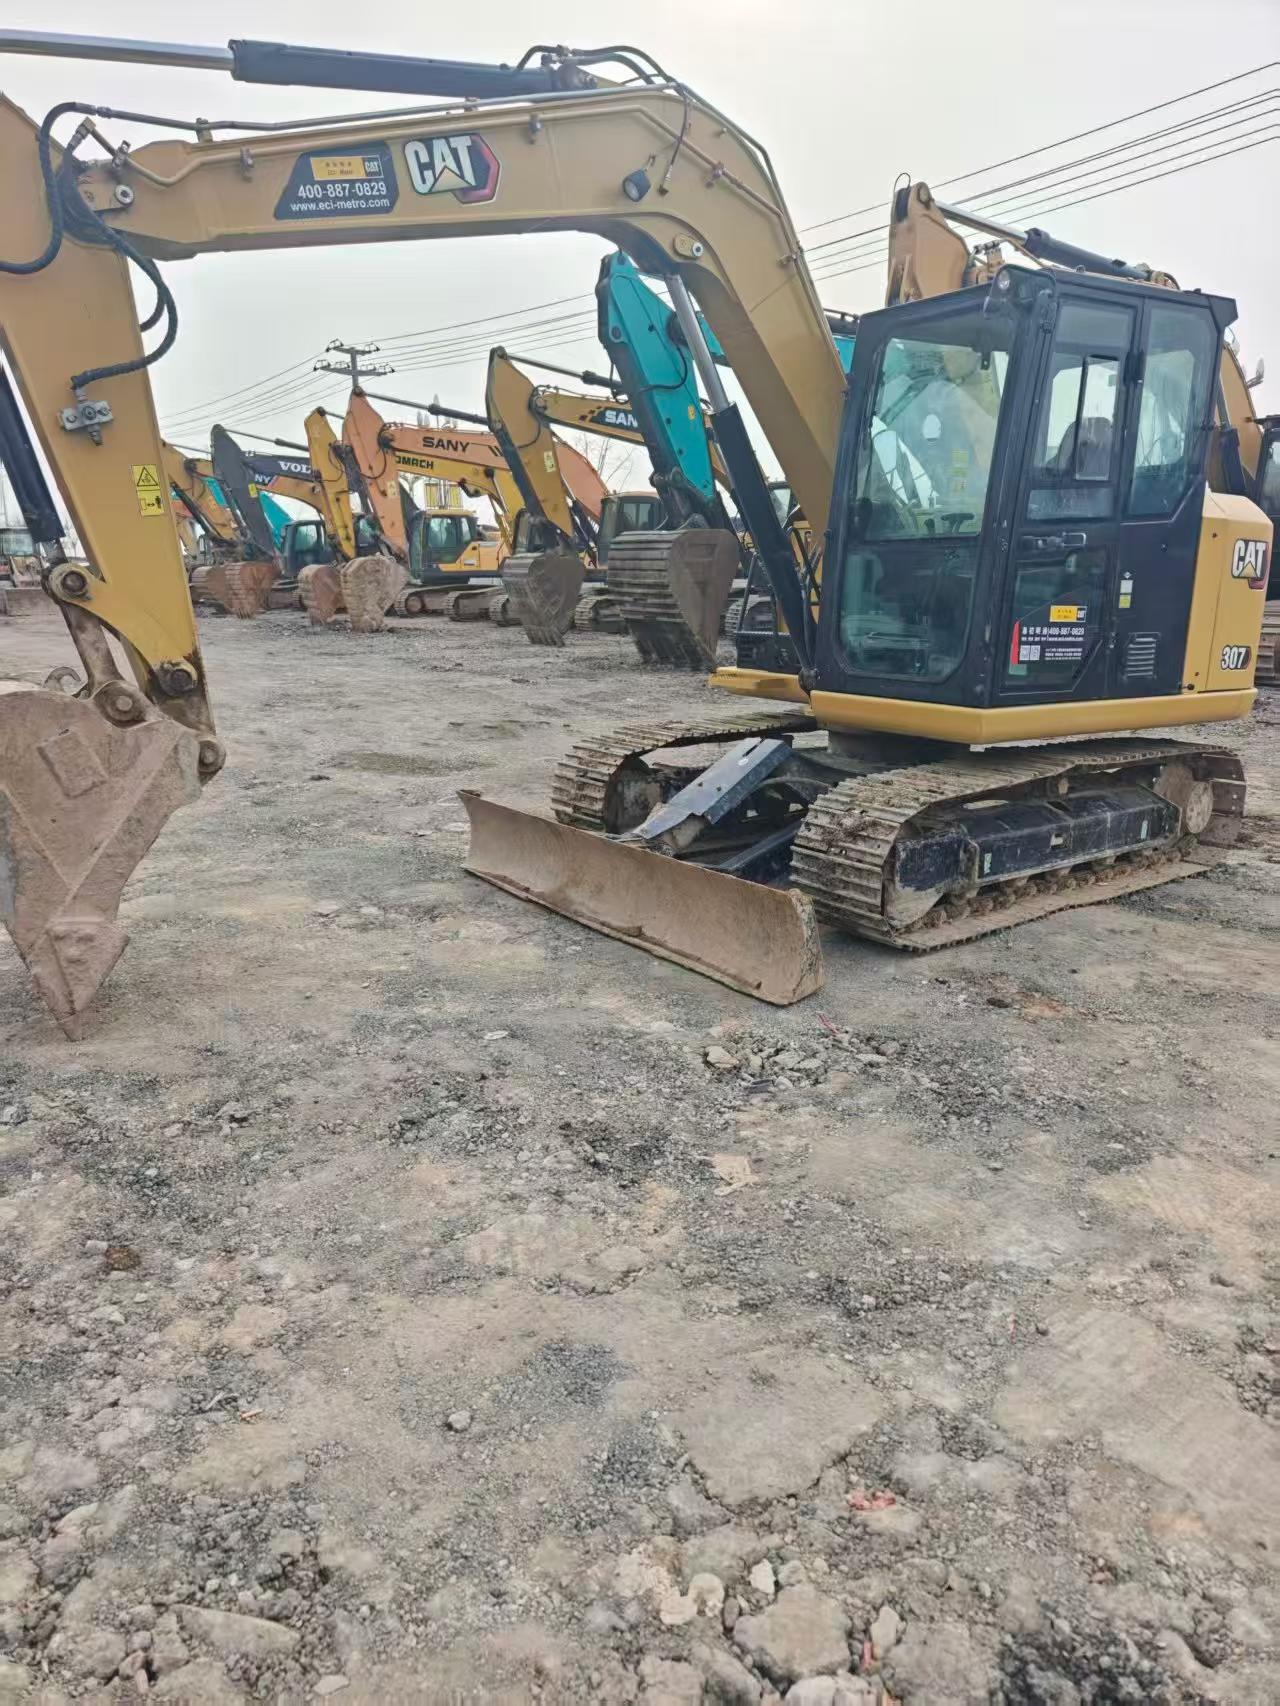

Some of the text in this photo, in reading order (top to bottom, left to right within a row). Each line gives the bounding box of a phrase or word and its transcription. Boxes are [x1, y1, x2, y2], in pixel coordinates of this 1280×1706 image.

[405, 135, 476, 194] CAT
[298, 181, 387, 199] 400-887-0829
[290, 197, 390, 212] www.eci-metro.com
[422, 436, 469, 452] SANY
[1232, 539, 1266, 578] CAT
[1221, 646, 1247, 670] 307
